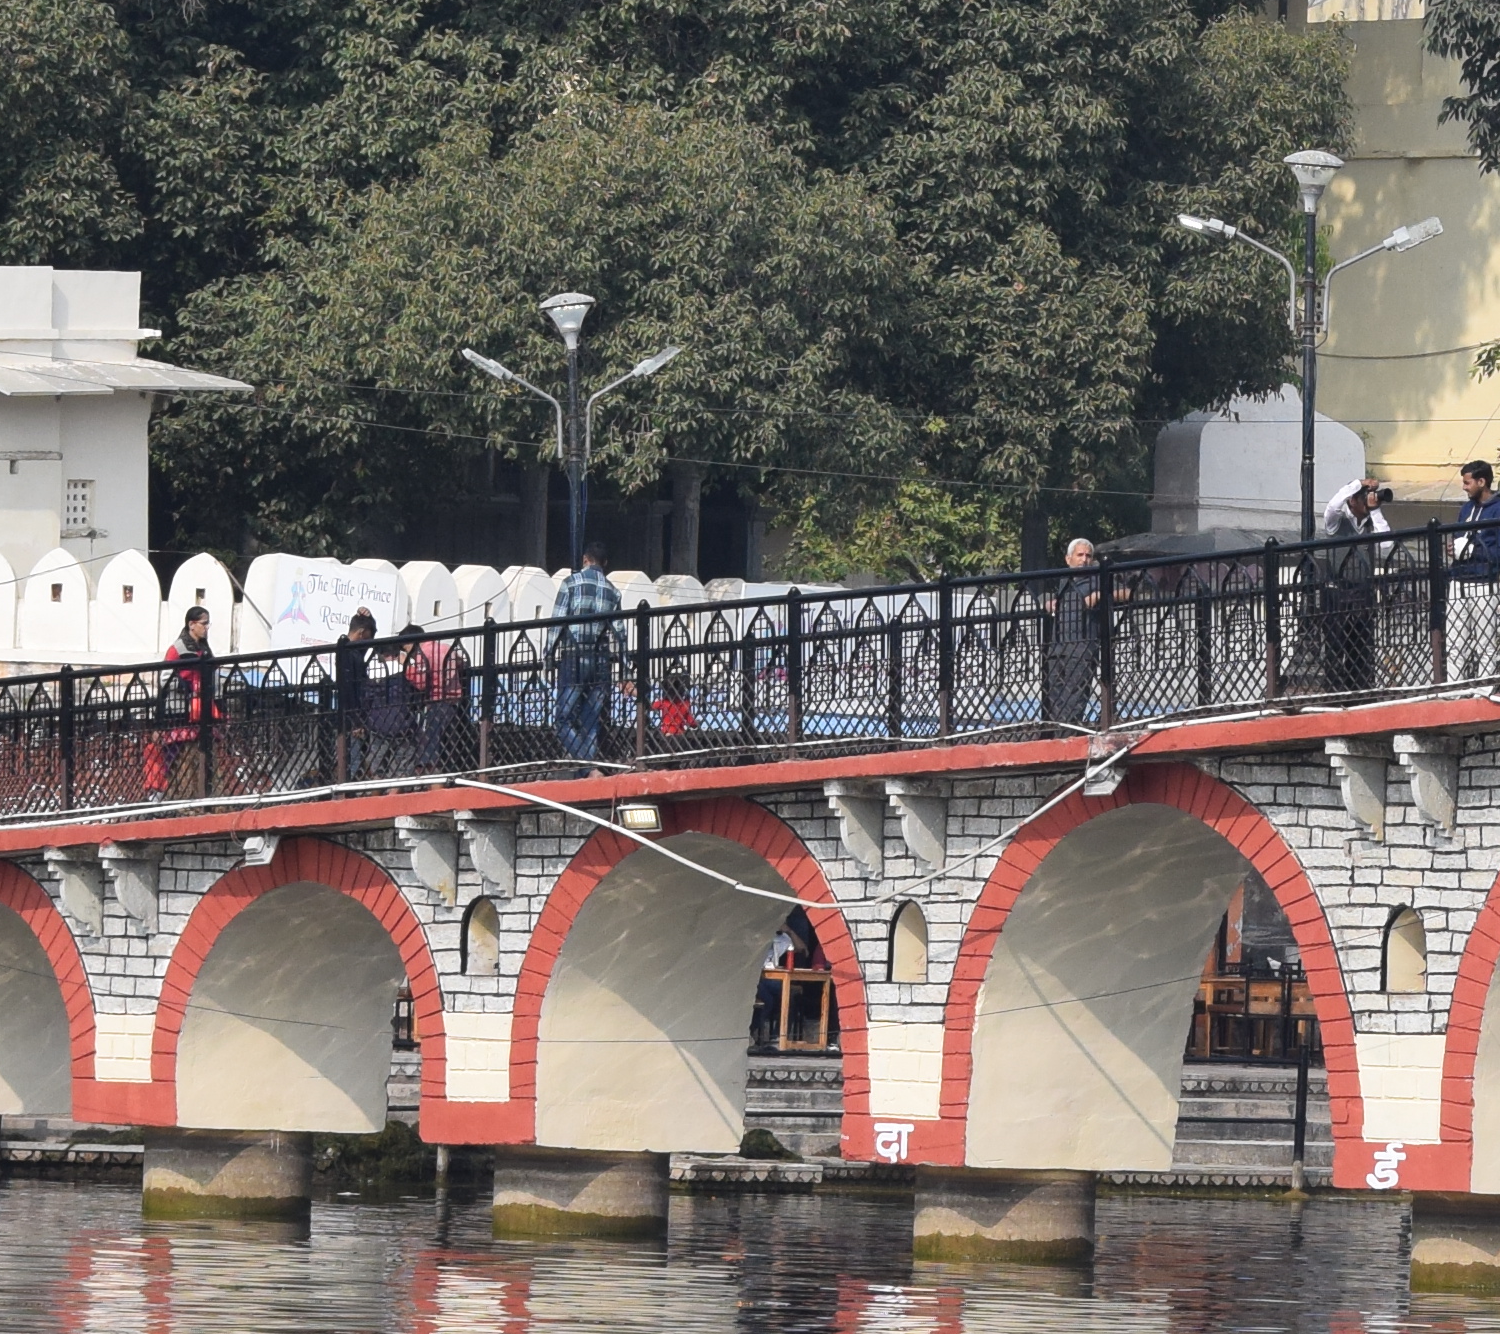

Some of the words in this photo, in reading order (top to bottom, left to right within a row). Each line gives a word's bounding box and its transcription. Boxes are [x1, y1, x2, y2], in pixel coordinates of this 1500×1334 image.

[307, 573, 328, 594] The
[331, 577, 355, 602] Little
[358, 582, 391, 605] Prince
[874, 1123, 914, 1164] दा
[1366, 1142, 1406, 1189] ई
